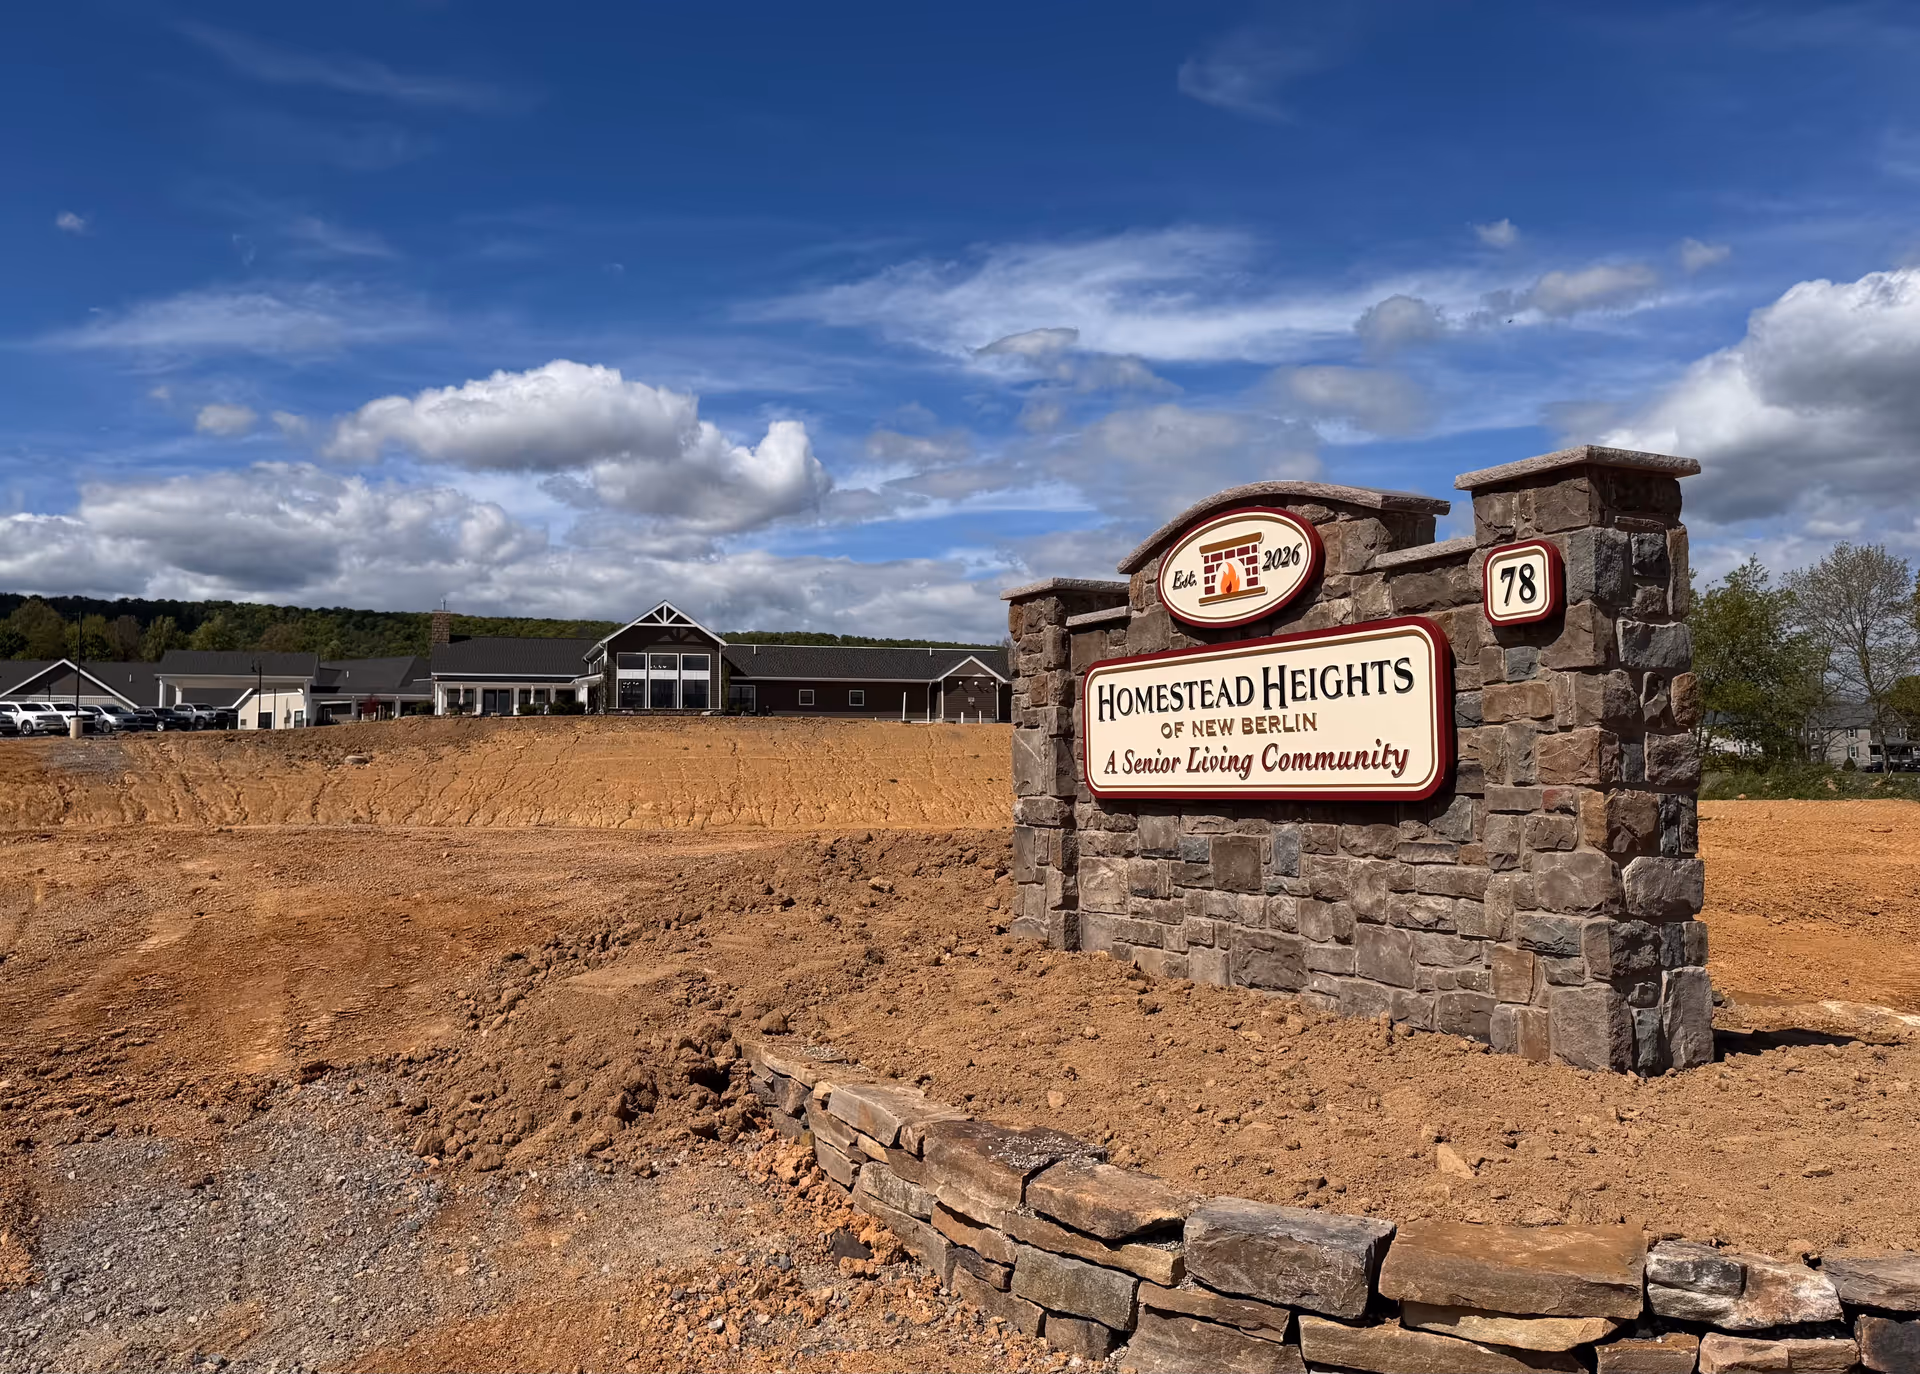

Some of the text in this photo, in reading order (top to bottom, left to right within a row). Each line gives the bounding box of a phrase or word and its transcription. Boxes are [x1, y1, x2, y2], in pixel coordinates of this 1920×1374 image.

[1172, 542, 1302, 591] Est. 2026
[1500, 562, 1538, 606] 78
[1097, 657, 1415, 722] HOMESTEAD HEIGHTS
[1161, 712, 1318, 738] OF NEW BERLIN
[1104, 739, 1410, 780] A Senior Living Community
